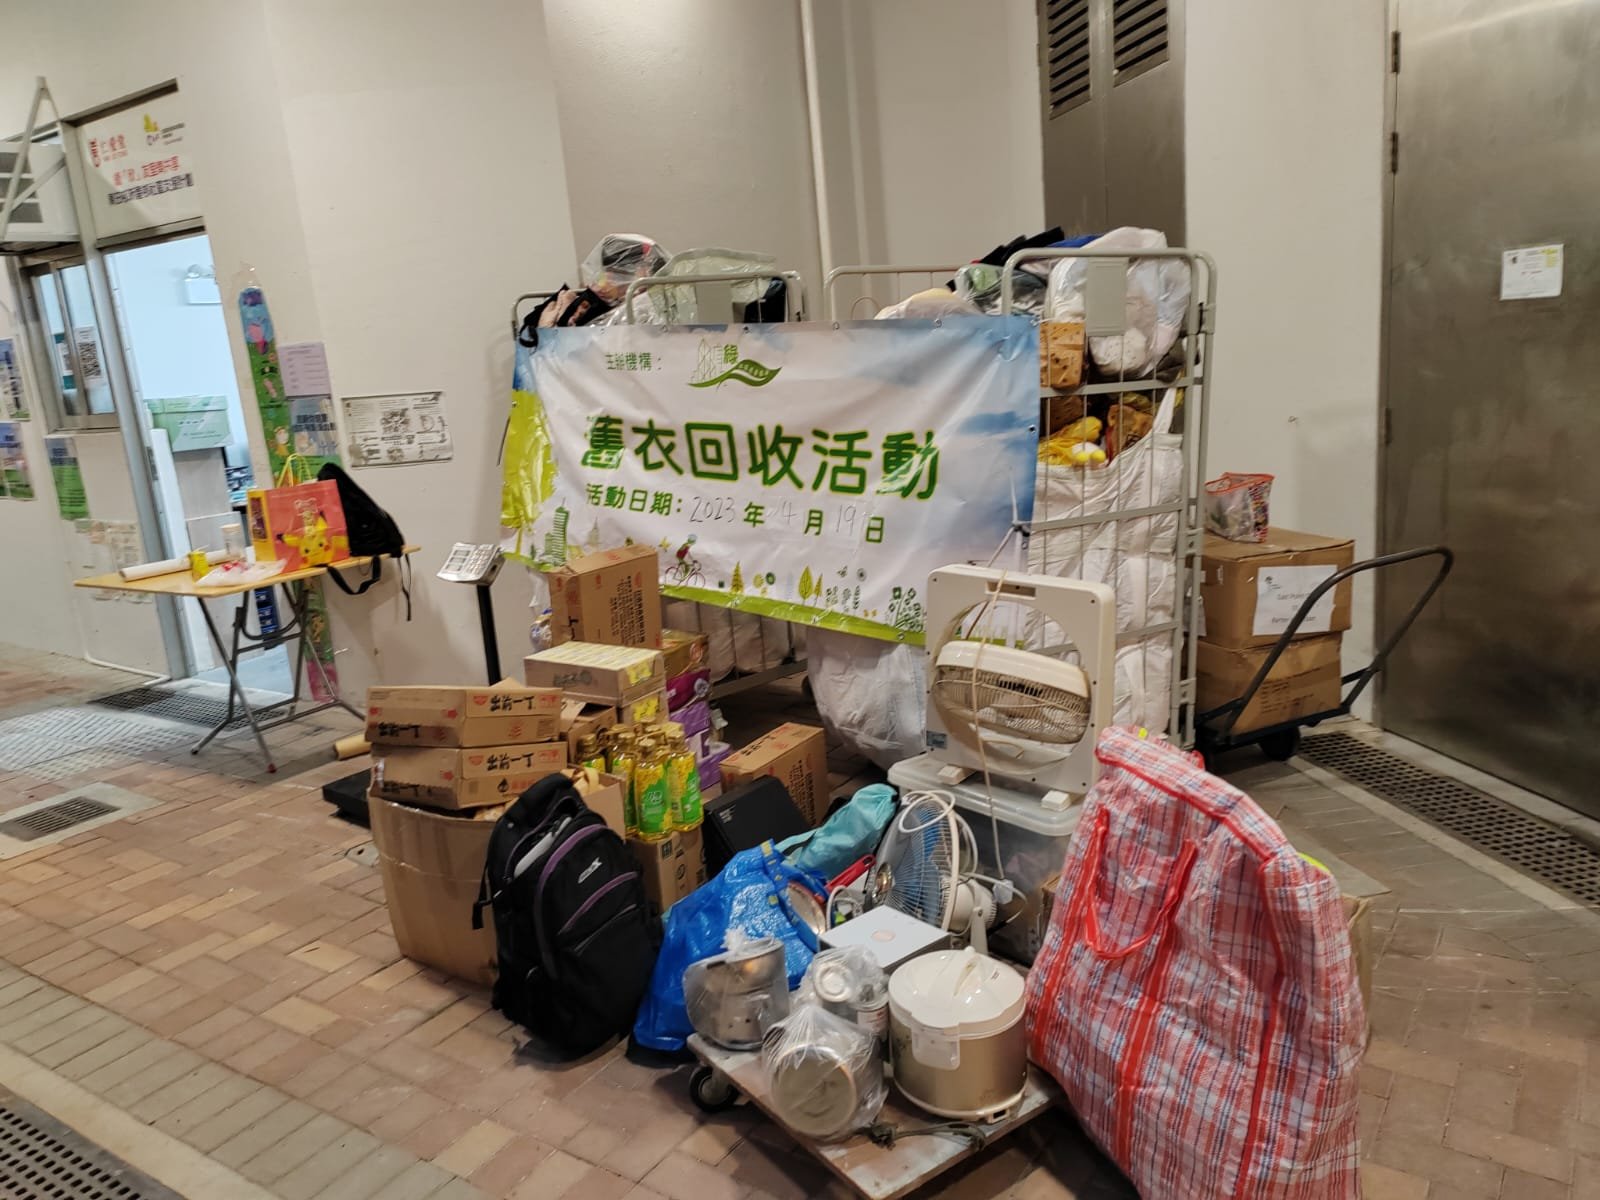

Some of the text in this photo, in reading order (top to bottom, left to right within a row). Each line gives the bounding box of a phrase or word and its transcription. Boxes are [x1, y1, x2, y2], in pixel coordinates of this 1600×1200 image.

[581, 415, 940, 500] 舊衣回收活動
[743, 502, 765, 527] 年
[804, 509, 824, 536] 月
[865, 516, 884, 544] 日
[490, 694, 535, 712] 出前一丁
[486, 752, 534, 772] 出前一丁
